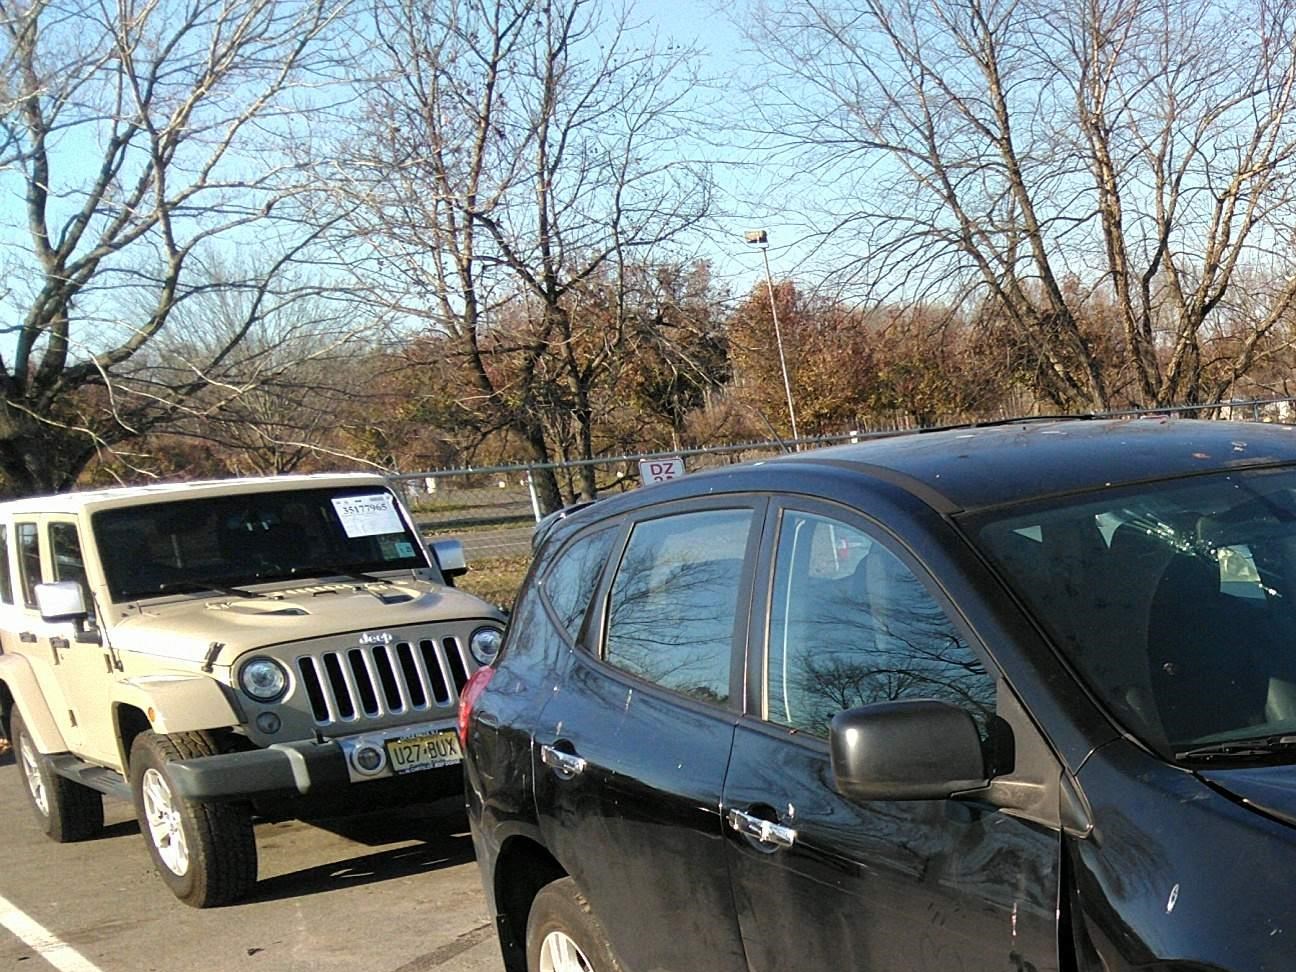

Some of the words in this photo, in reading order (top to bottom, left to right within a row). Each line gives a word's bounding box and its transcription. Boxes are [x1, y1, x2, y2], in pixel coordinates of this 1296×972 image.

[650, 463, 675, 475] DZ
[342, 503, 388, 515] 35177965
[359, 632, 393, 645] Jeep
